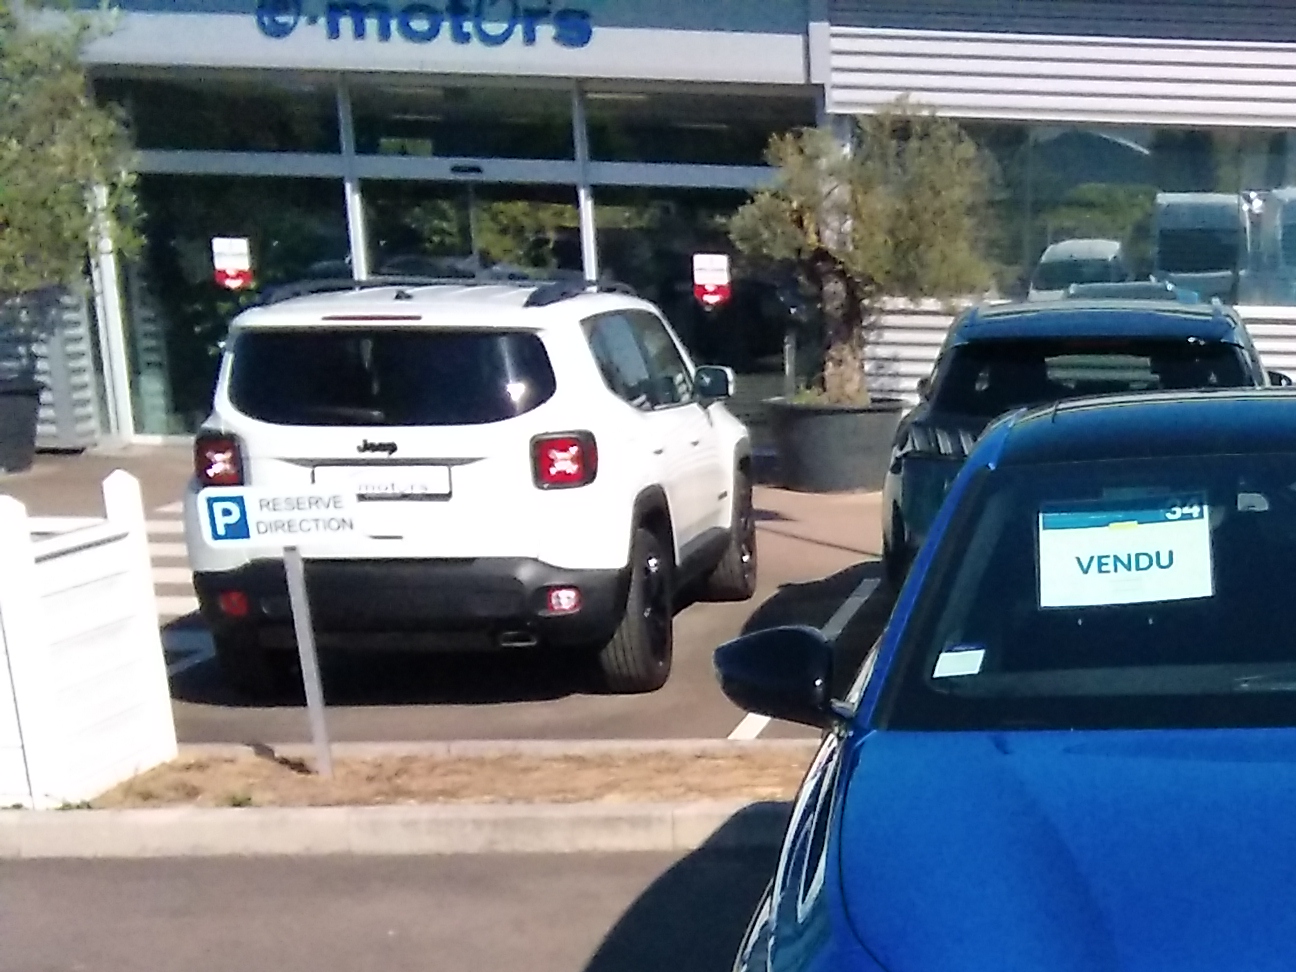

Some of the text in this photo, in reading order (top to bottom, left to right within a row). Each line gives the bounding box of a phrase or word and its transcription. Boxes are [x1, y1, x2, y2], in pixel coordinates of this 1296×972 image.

[358, 483, 428, 492] motrs
[213, 502, 240, 536] P
[256, 517, 354, 535] DIRECTION
[1075, 550, 1174, 575] VENDU
